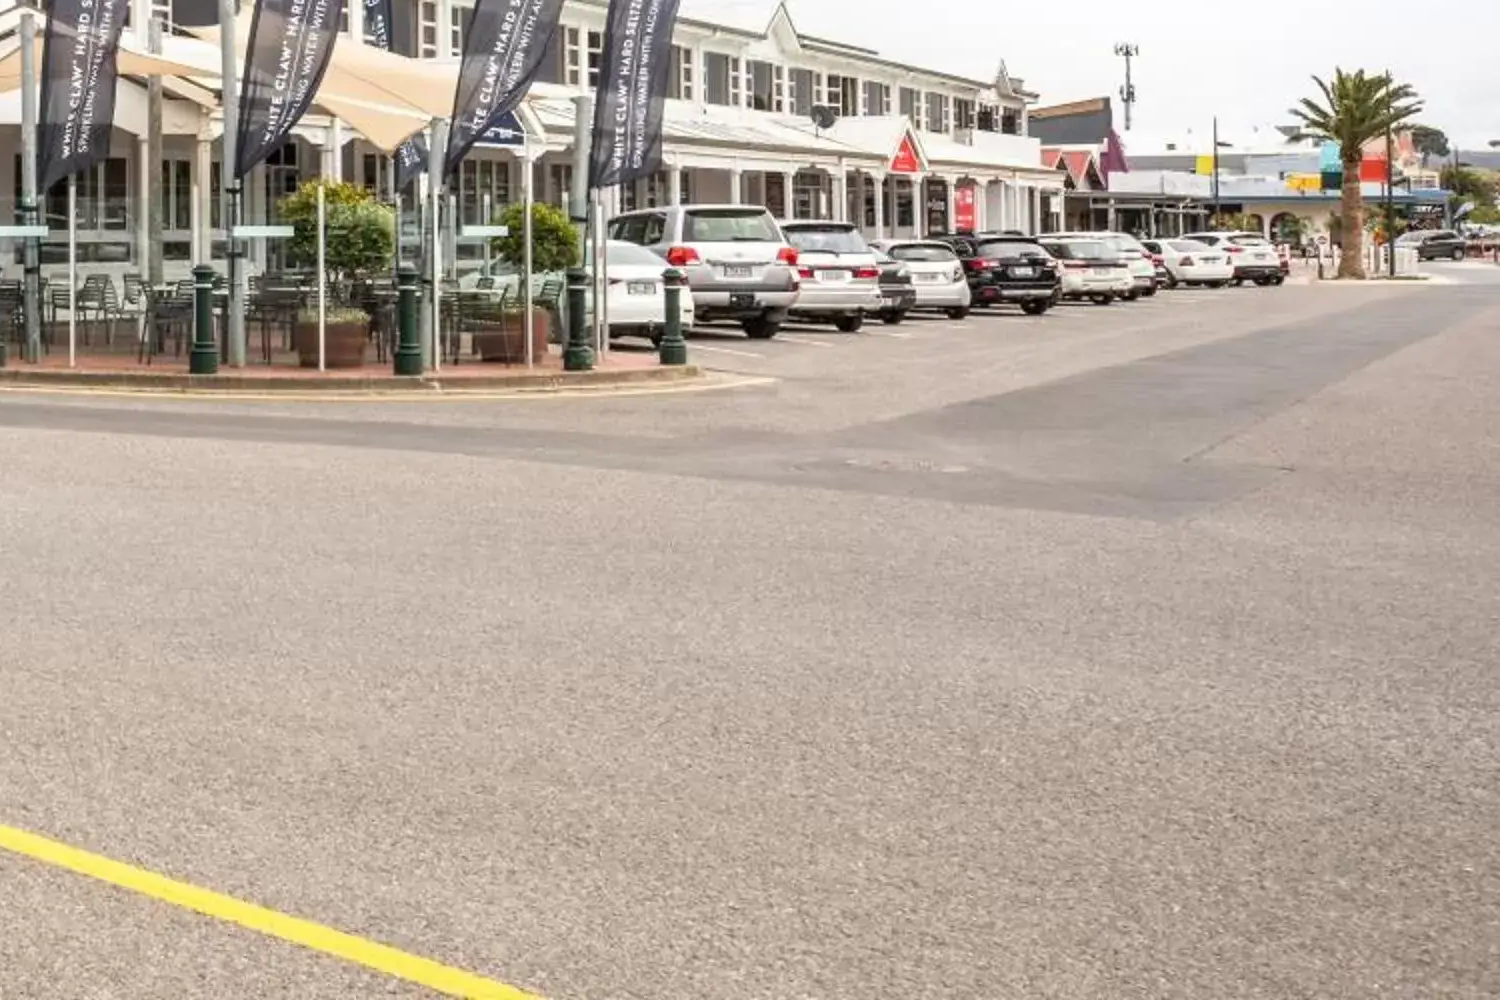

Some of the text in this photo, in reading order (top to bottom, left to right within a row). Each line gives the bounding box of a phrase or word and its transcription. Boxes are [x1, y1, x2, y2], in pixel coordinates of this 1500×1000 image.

[75, 13, 91, 55] HARD
[99, 12, 113, 46] WITH
[494, 10, 517, 54] HARD
[520, 15, 538, 50] WITH
[301, 35, 318, 77] WATER
[612, 126, 625, 170] WHITE
[620, 39, 634, 76] HARD
[637, 65, 649, 105] WATER
